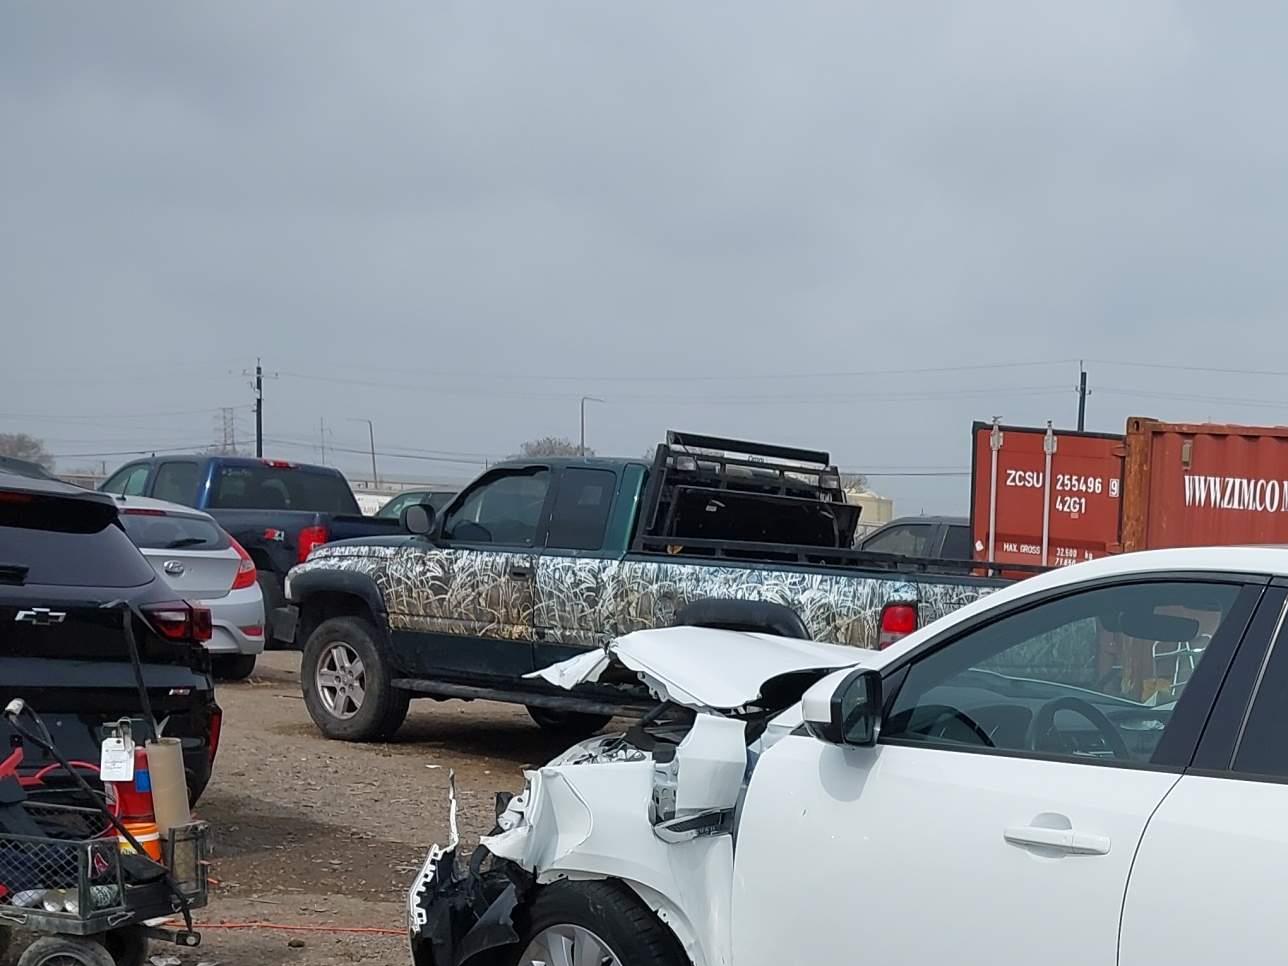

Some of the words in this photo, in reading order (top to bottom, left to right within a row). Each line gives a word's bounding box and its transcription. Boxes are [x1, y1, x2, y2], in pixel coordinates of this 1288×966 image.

[1006, 469, 1043, 488] ZCSU
[1056, 474, 1102, 494] 255496
[1055, 495, 1087, 514] 42G1
[1020, 544, 1041, 555] GROSS
